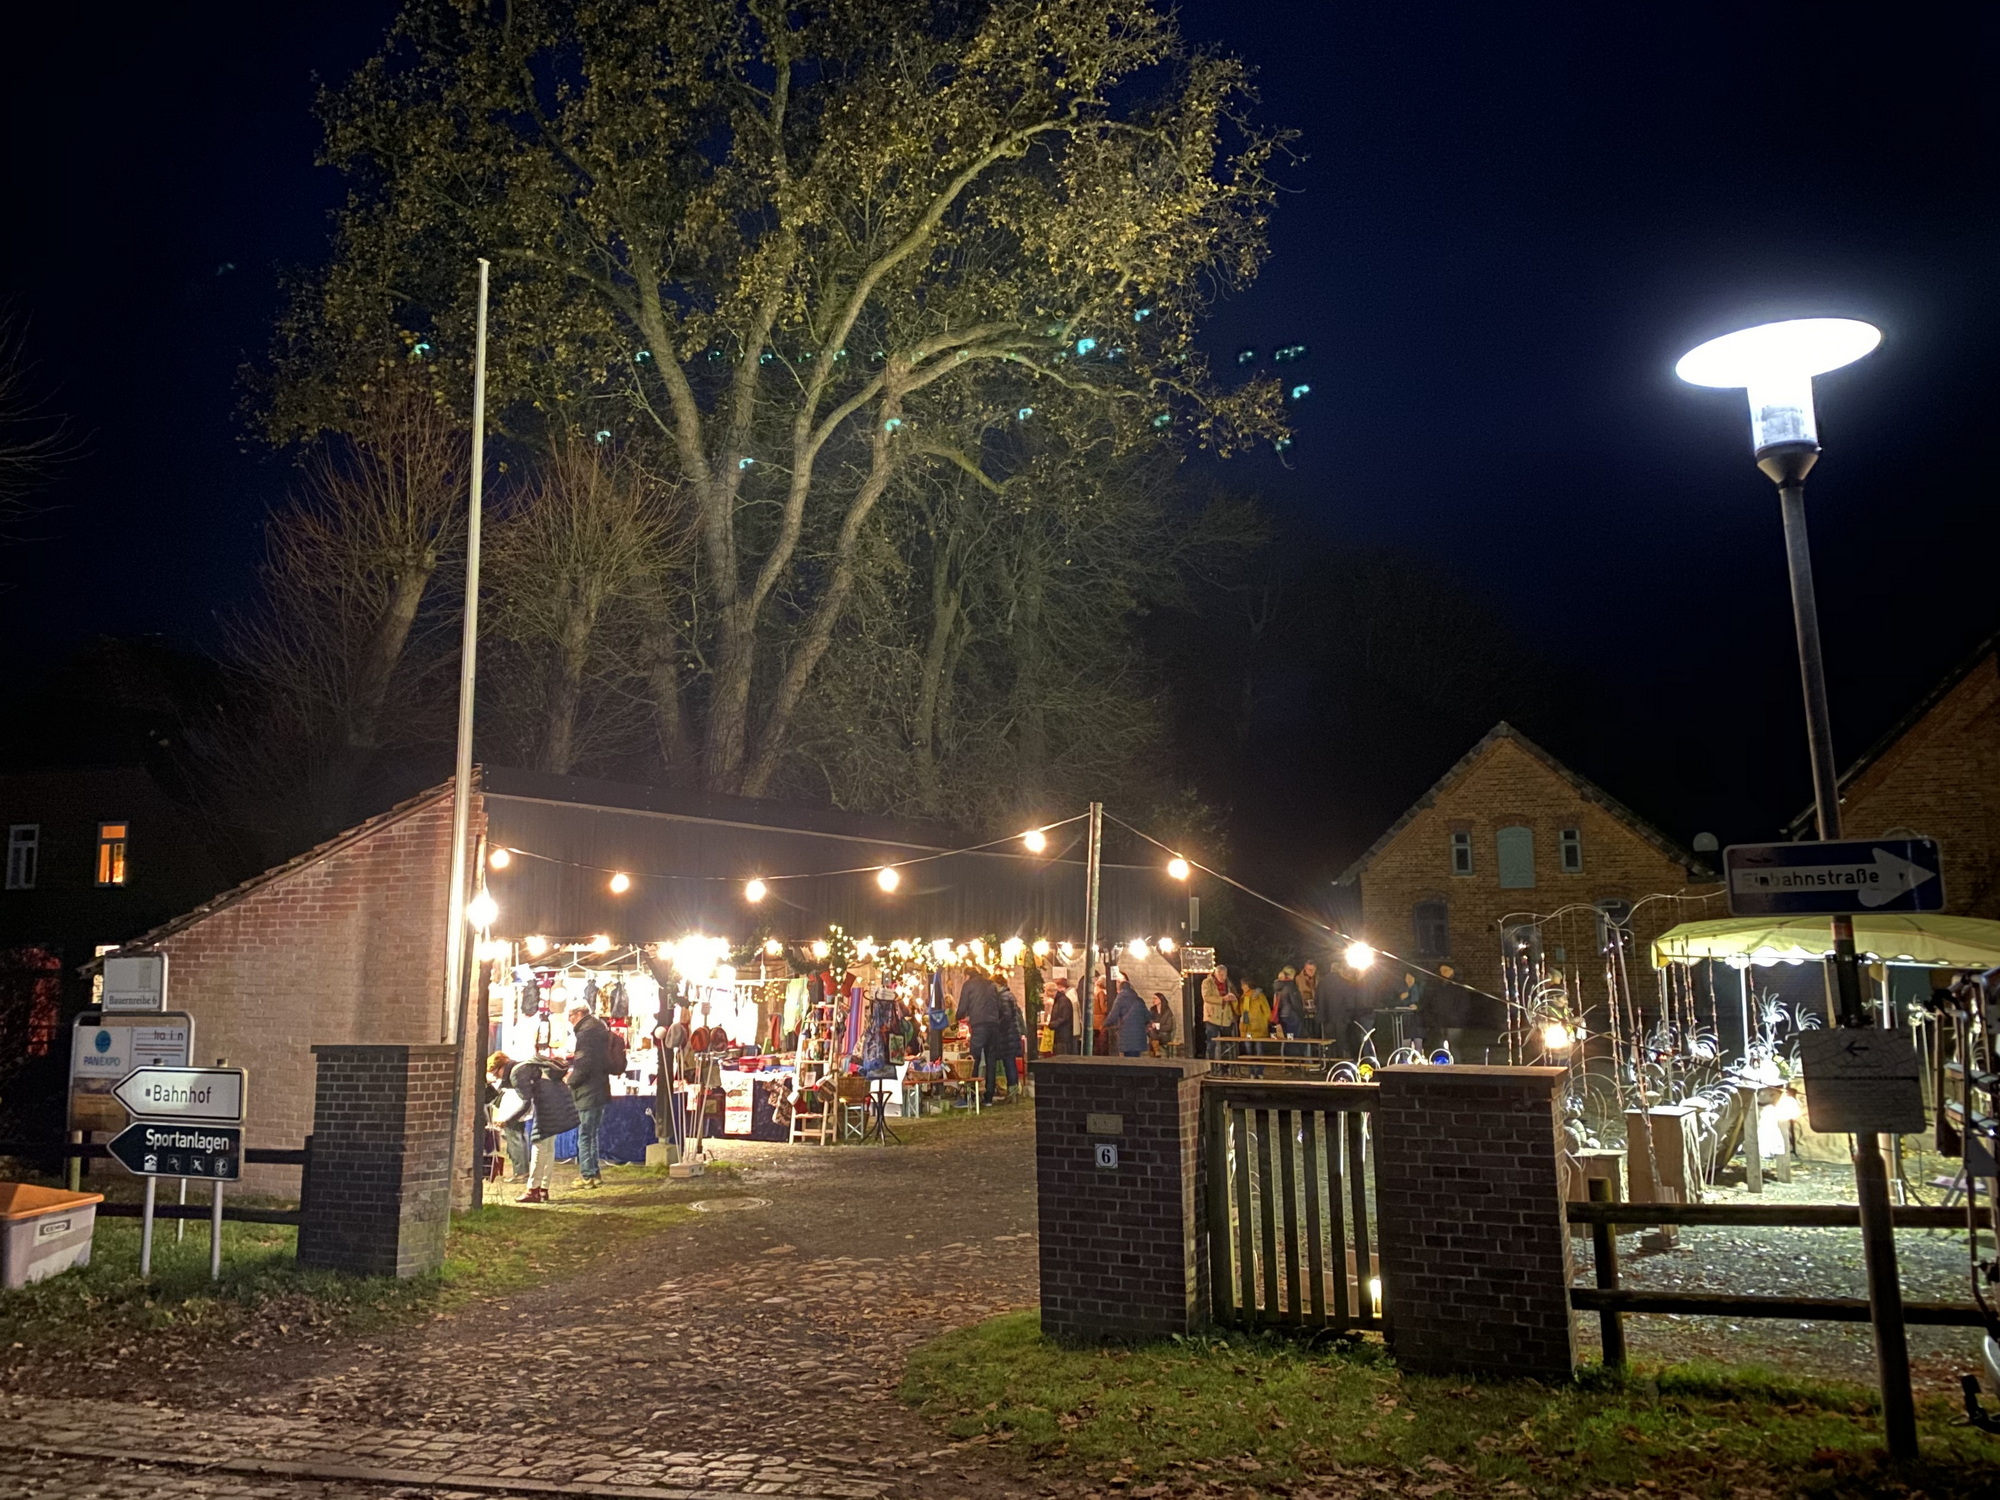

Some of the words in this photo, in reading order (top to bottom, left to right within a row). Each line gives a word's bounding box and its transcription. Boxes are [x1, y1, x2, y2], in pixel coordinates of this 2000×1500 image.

[108, 995, 151, 1005] Bauernreihe
[152, 995, 157, 1005] 6
[153, 1085, 211, 1104] Bahnhof
[145, 1128, 230, 1154] Sportanlagen
[1101, 1148, 1111, 1164] 6
